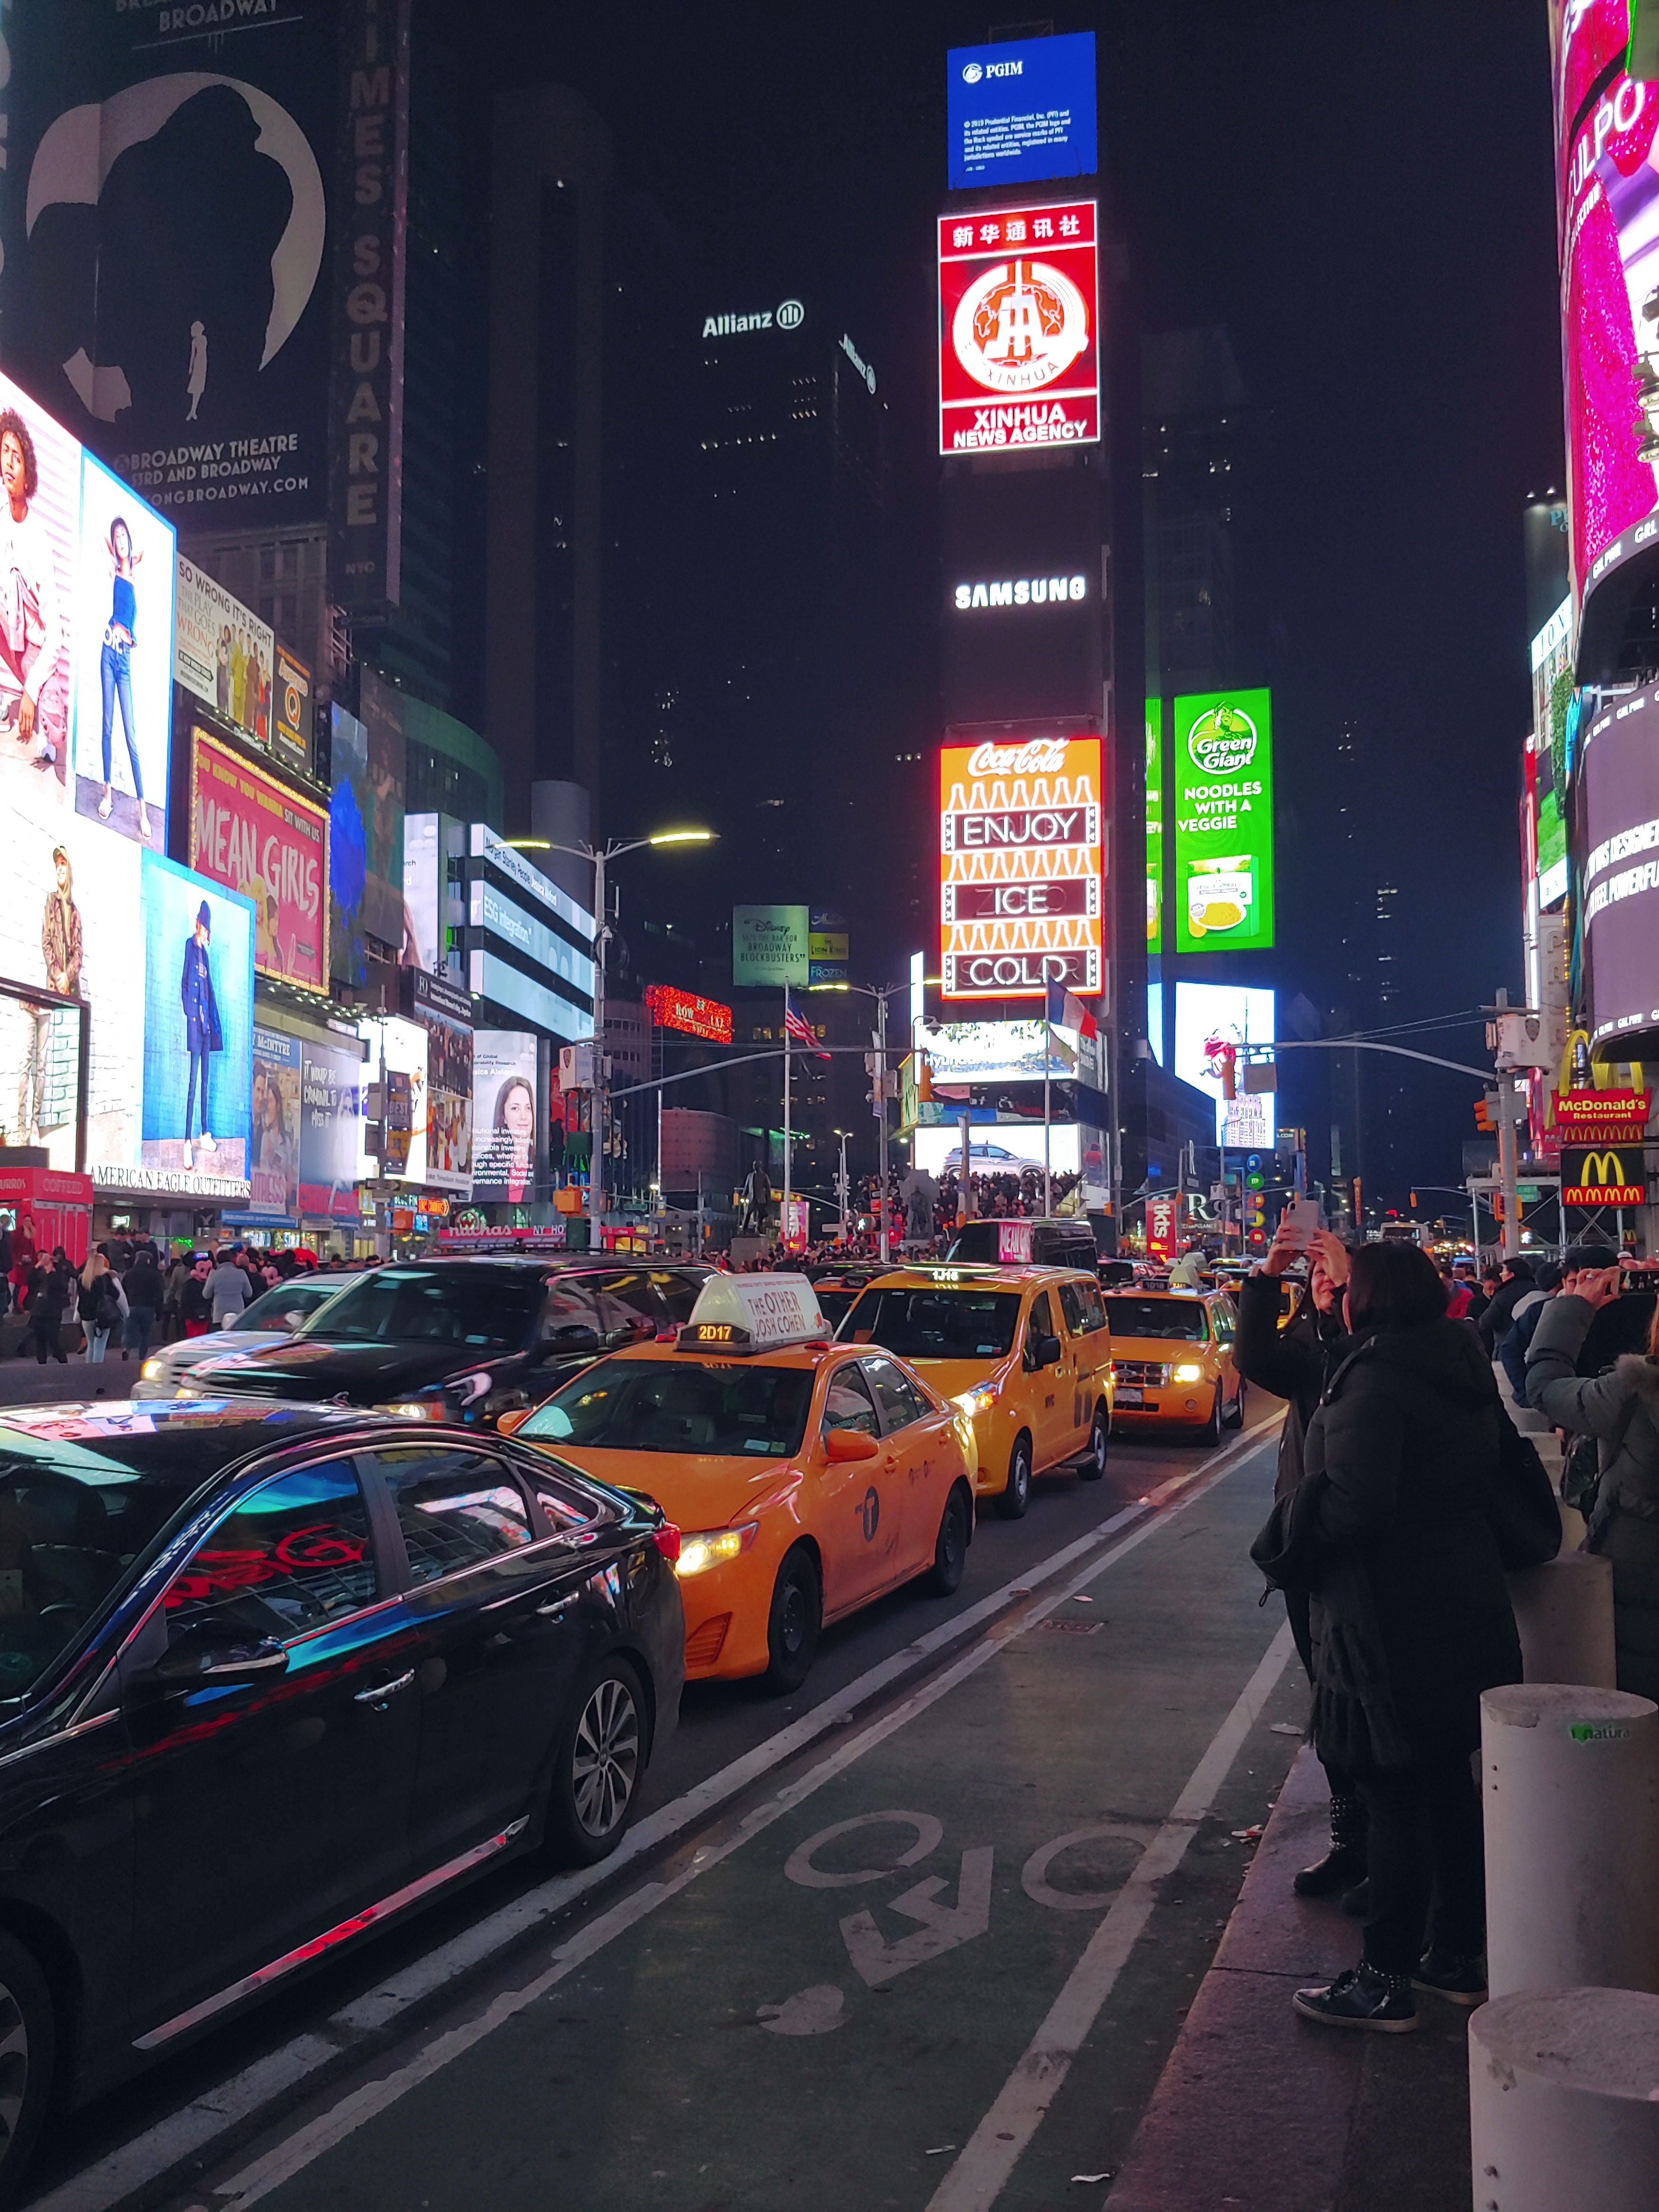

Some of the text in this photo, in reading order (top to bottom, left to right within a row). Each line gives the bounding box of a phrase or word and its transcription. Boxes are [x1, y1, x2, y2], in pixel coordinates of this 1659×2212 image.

[986, 61, 1023, 79] PGIM
[350, 0, 389, 204] IMES
[953, 214, 1080, 248] 新华通讯社
[702, 310, 772, 338] Allianz
[346, 235, 387, 526] SQUARE
[987, 361, 1059, 386] XINHUA
[973, 402, 1067, 430] XINHUA
[953, 419, 1088, 448] NEWS AGENCY
[131, 433, 298, 471] BROADWAY THEATRE
[167, 466, 197, 484] AND
[200, 455, 281, 479] BROADWAY
[146, 476, 309, 507] ONGBROADWAY.COM
[179, 561, 272, 648] SO WRONG IT'S RIGHT
[194, 592, 213, 617] PLAY
[954, 575, 1086, 609] SAMSUNG
[178, 596, 216, 637] THAT GOES
[177, 612, 215, 659] WRONG
[1196, 737, 1253, 754] Green
[1203, 751, 1255, 770] Giant
[1184, 781, 1262, 801] NOODLES
[1194, 799, 1252, 815] WITH A
[284, 808, 294, 825] SIT
[295, 813, 311, 836] WITH
[311, 826, 320, 843] US
[963, 810, 1078, 846] ENJOY
[1178, 814, 1238, 833] VEGGIE
[195, 792, 319, 920] MEAN GIRLS
[1608, 859, 1659, 904] POWERFU
[484, 895, 499, 924] ESG
[995, 885, 1049, 915] ICE
[748, 942, 791, 953] BROADWAY
[811, 945, 827, 955] LION
[810, 965, 847, 979] FROZEN
[969, 955, 1068, 986] COLD
[257, 1034, 290, 1057] McINTYRE
[304, 1060, 312, 1080] IT
[328, 1069, 337, 1085] BE
[304, 1085, 331, 1107] CRIMINAL
[389, 1101, 409, 1115] BEST
[1558, 1099, 1646, 1112] McDonald's
[1573, 1111, 1632, 1120] Restaurant
[488, 1160, 515, 1169] specific
[91, 1165, 251, 1199] AMERICAN EAGLE OUTFITTERS
[409, 1195, 418, 1206] FIN
[1186, 1193, 1216, 1220] R
[449, 1224, 565, 1237] nuchas NY HO
[1153, 1203, 1171, 1239] tkts
[747, 1290, 801, 1316] THE OTHER
[698, 1325, 733, 1341] 2D17
[755, 1313, 807, 1338] JOSH COHEN
